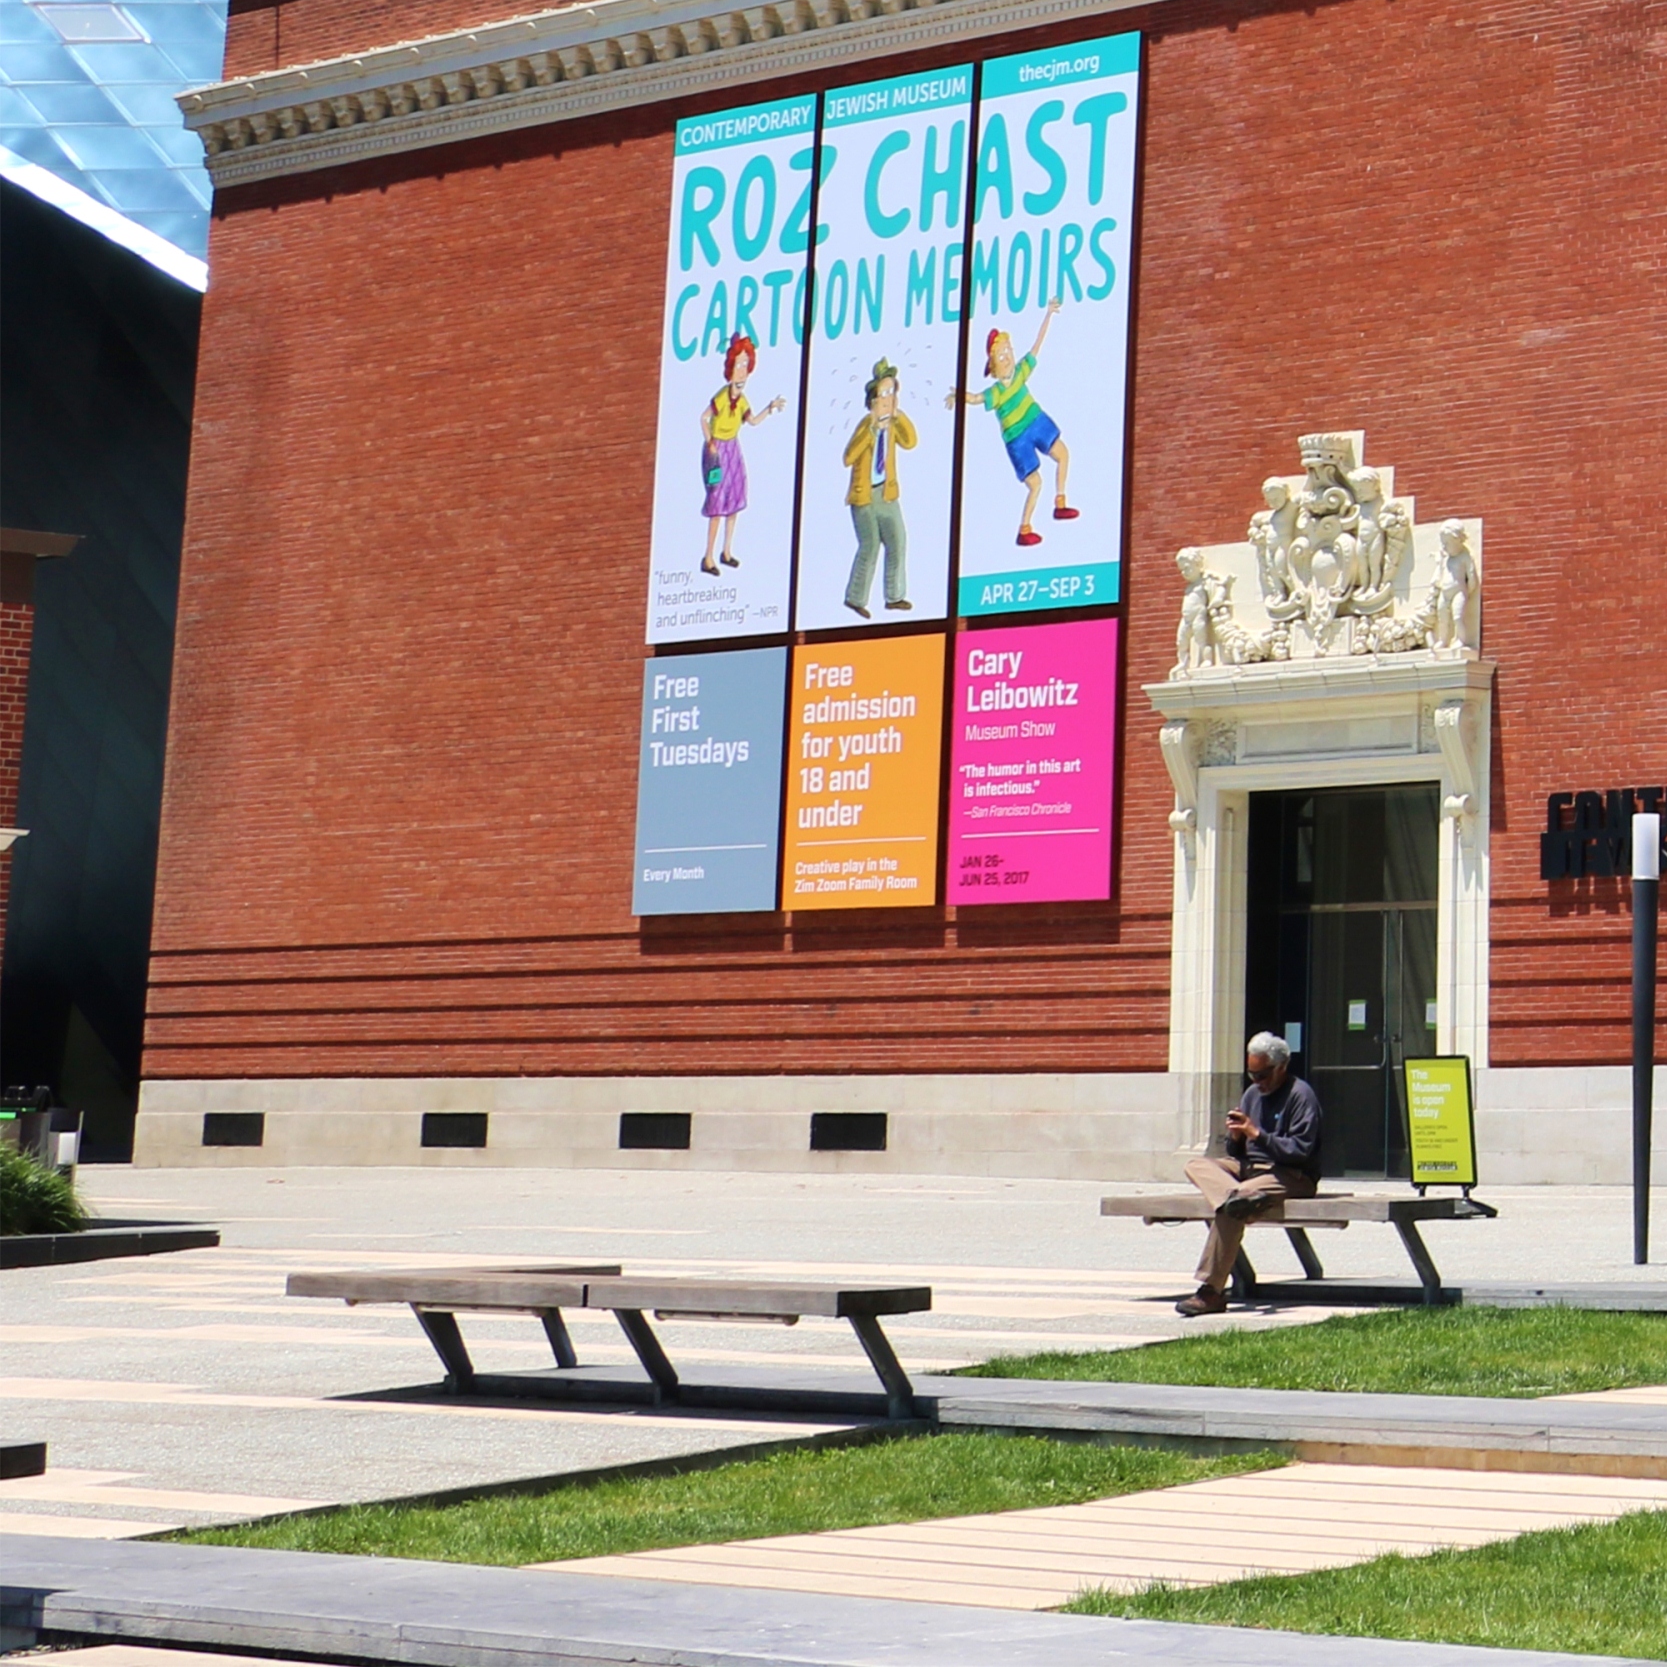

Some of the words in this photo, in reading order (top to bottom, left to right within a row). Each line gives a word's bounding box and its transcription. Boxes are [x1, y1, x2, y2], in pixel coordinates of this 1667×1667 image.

[1019, 55, 1100, 82] thecjm.org
[826, 91, 888, 120] JEWISH
[892, 76, 966, 107] MUSEUM
[680, 104, 811, 147] CONTEMPORARY
[679, 145, 838, 272] ROZ
[864, 91, 1128, 238] CHAST
[672, 253, 850, 361] CARTOON
[904, 217, 1117, 328] MEMOIRS
[655, 570, 693, 586] “funny,
[980, 582, 1014, 606] APR
[1084, 574, 1095, 595] 3
[657, 586, 737, 606] heartbreaking
[656, 612, 678, 628] and
[681, 604, 750, 624] unflinching”
[804, 663, 853, 689] Free
[968, 649, 1023, 679] Cary
[654, 674, 699, 700] Free
[966, 677, 1079, 712] Leibowitz
[652, 706, 700, 733] First
[803, 690, 916, 724] admission
[801, 731, 833, 759] for
[838, 725, 902, 762] youth
[965, 724, 1018, 741] Museum
[1021, 721, 1056, 738] Show
[650, 737, 749, 767] Tuesdays
[799, 766, 824, 794] 18
[829, 762, 870, 792] and
[959, 764, 986, 778] “The
[987, 762, 1024, 777] humor
[1026, 760, 1037, 774] in
[1039, 758, 1061, 773] this
[1063, 758, 1081, 772] art
[963, 783, 974, 798] is
[976, 779, 1041, 797] infectious.”
[798, 799, 862, 828] under
[989, 804, 1030, 818] Francisco
[1031, 802, 1072, 816] Chronicle
[643, 867, 671, 883] Every
[673, 866, 704, 880] Month
[795, 859, 840, 875] Creative
[842, 859, 865, 875] play
[867, 857, 877, 871] in
[879, 857, 898, 871] the
[959, 855, 982, 869] JAN
[794, 878, 814, 893] Zim
[816, 878, 847, 892] Zoom
[849, 876, 884, 892] Family
[886, 876, 918, 889] Room
[959, 873, 982, 887] JUN
[984, 871, 1001, 887] 25,
[1003, 870, 1030, 885] 2017
[1411, 1069, 1428, 1080] The
[1412, 1082, 1452, 1092] Museum
[1413, 1096, 1421, 1105] is
[1421, 1096, 1444, 1106] open
[1414, 1107, 1439, 1119] today
